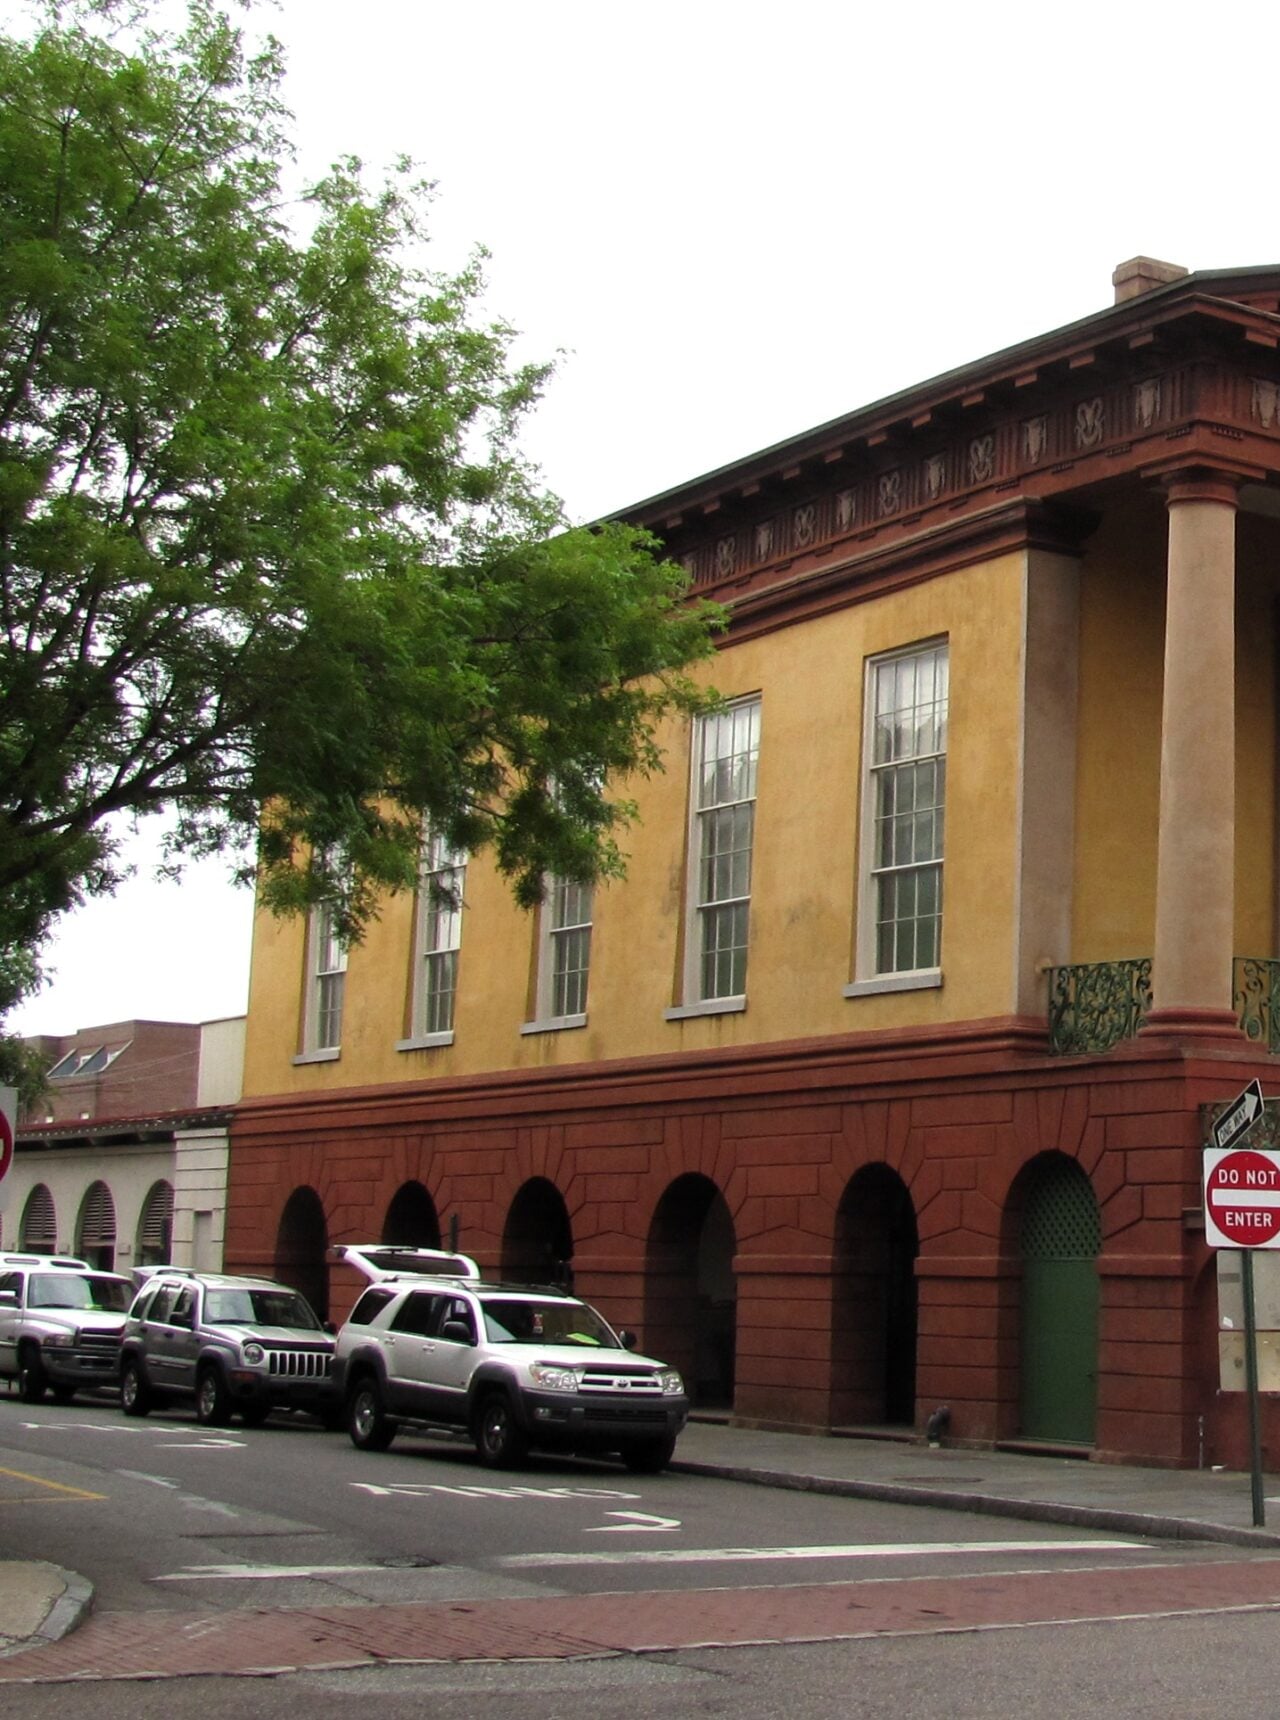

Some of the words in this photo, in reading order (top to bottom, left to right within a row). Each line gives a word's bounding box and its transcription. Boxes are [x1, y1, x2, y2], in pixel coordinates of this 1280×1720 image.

[1220, 1121, 1235, 1141] ONE
[1234, 1107, 1247, 1127] WAY
[1218, 1169, 1239, 1184] DO
[1246, 1170, 1276, 1185] NOT
[1225, 1211, 1272, 1227] ENTER
